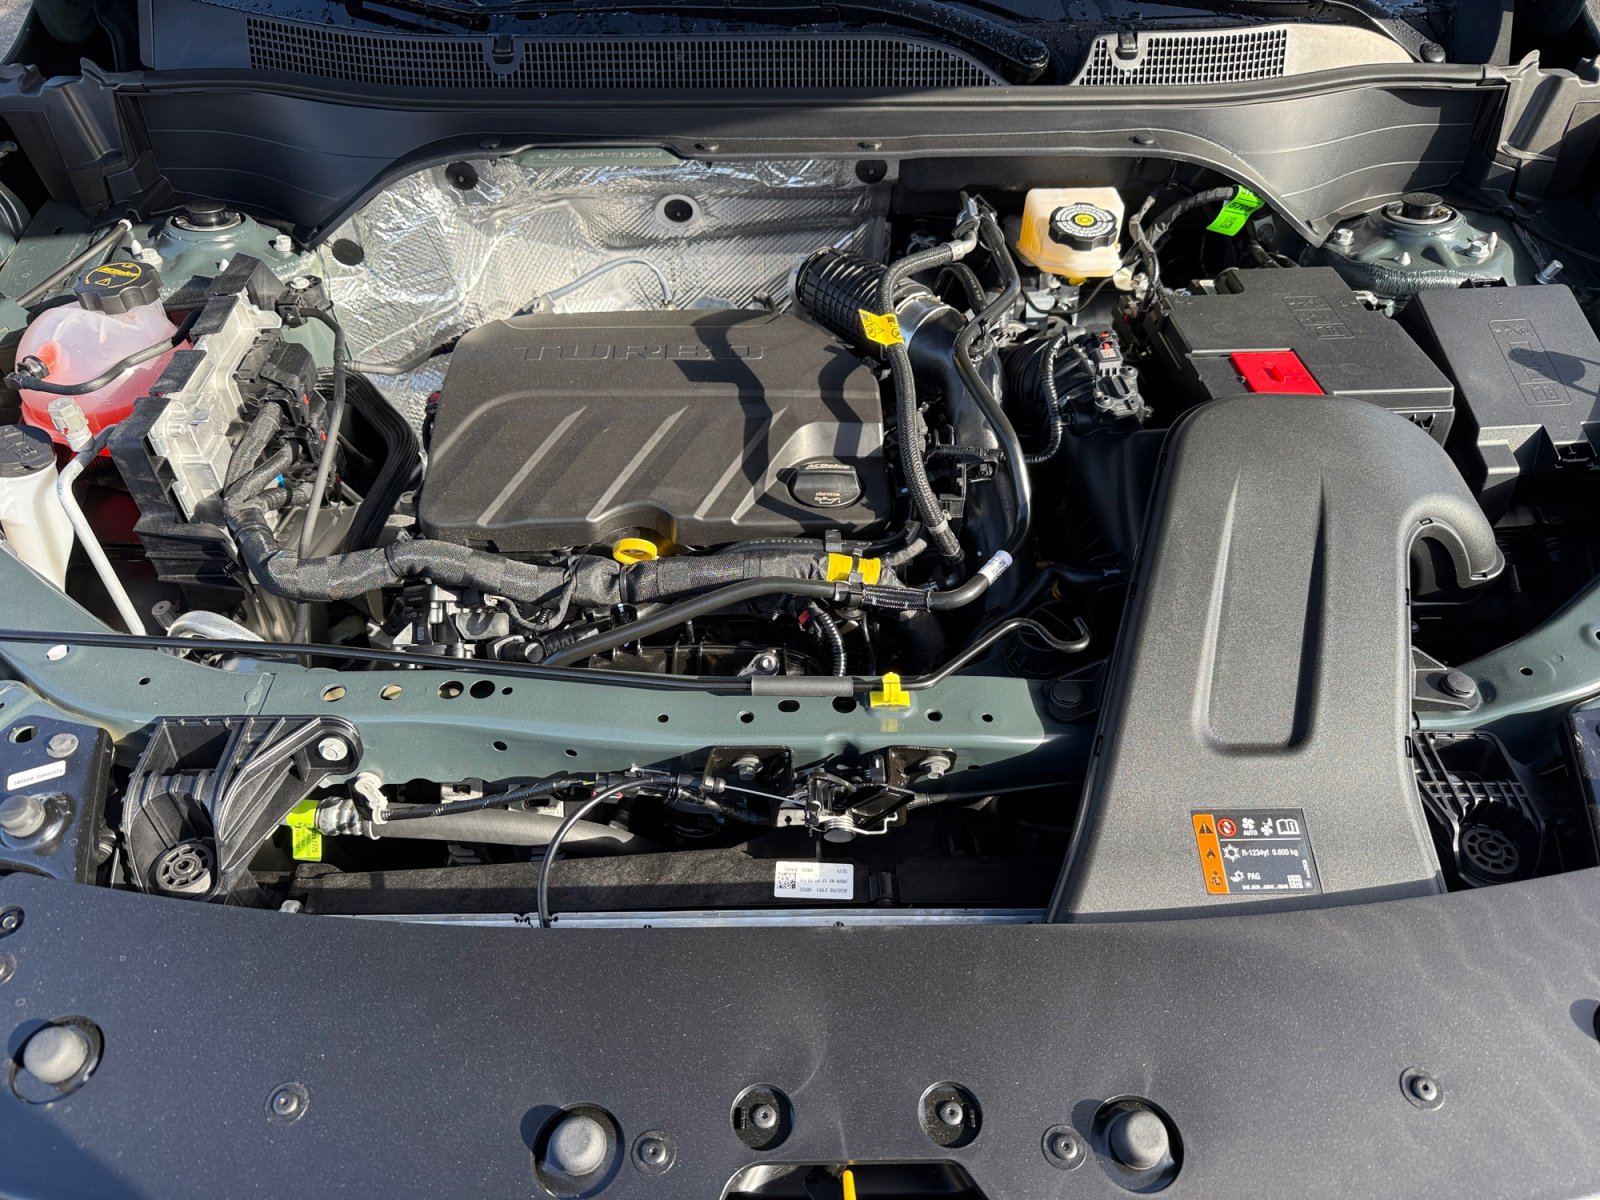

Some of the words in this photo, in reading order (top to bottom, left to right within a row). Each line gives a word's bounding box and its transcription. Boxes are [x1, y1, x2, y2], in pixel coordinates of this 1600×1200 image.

[512, 344, 764, 360] TURBO
[1289, 847, 1299, 857] kg
[1247, 872, 1261, 880] PAG
